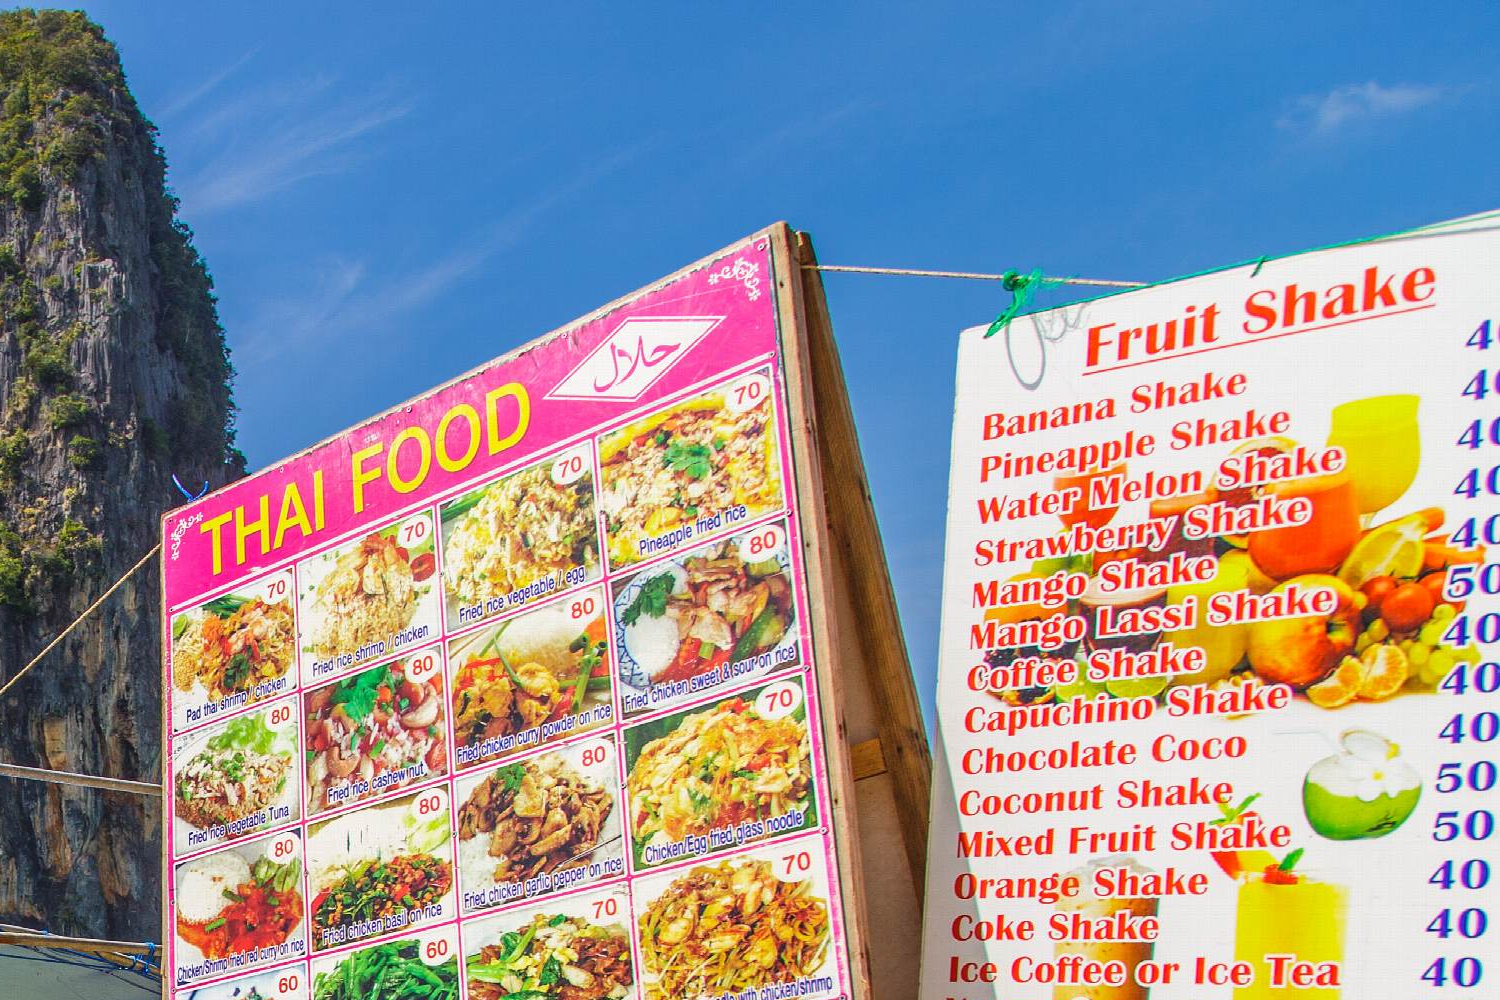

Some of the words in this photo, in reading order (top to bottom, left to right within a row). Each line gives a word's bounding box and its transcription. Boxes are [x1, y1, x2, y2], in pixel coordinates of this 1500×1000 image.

[1086, 302, 1220, 368] Fruit
[1242, 265, 1436, 334] Shake
[593, 335, 681, 393] حلال
[735, 382, 760, 405] 70
[983, 398, 1116, 440] Banana
[1130, 372, 1247, 414] Shake
[980, 431, 1155, 483] Pineapple
[1170, 408, 1290, 451] Shake
[200, 469, 325, 575] THAI
[350, 381, 530, 514] FOOD
[978, 488, 1079, 524] Water
[1091, 470, 1202, 506] Melon
[1218, 446, 1342, 488] Shake
[639, 522, 693, 556] Pineapple
[696, 513, 722, 535] fried
[724, 504, 747, 524] rice
[974, 518, 1174, 566] Strawberry
[1186, 496, 1308, 538] Shake
[460, 601, 483, 623] Fried
[486, 597, 504, 613] rice
[507, 576, 555, 604] vegetable
[565, 566, 585, 585] egg
[970, 615, 1084, 650] Mango
[1099, 598, 1194, 638] Lassi
[1208, 587, 1333, 624] Shake
[312, 660, 334, 677] Fried
[337, 655, 353, 668] rice
[355, 641, 385, 663] shrimp
[394, 624, 429, 648] chicken
[964, 695, 1154, 737] Capuchino
[1168, 684, 1289, 717] Shake
[962, 740, 1137, 774] Chocolate
[1152, 733, 1248, 762] Coco
[1435, 760, 1498, 793] 50
[327, 786, 350, 803] Fried
[351, 780, 369, 794] rice
[371, 770, 405, 789] cashew
[408, 762, 425, 777] nut
[188, 828, 208, 847] Fried
[210, 823, 225, 838] rice
[226, 812, 266, 837] vegetable
[268, 805, 290, 824] Tuna
[957, 828, 1054, 858] Mixed
[1069, 824, 1157, 854] Fruit
[1171, 820, 1291, 851] Shake
[1432, 810, 1495, 842] 50
[426, 939, 448, 959] 60
[949, 956, 998, 983] Ice
[1011, 956, 1124, 984] Coffee
[1137, 960, 1180, 984] or
[1194, 957, 1251, 985] Ice
[1267, 956, 1341, 986] Tea
